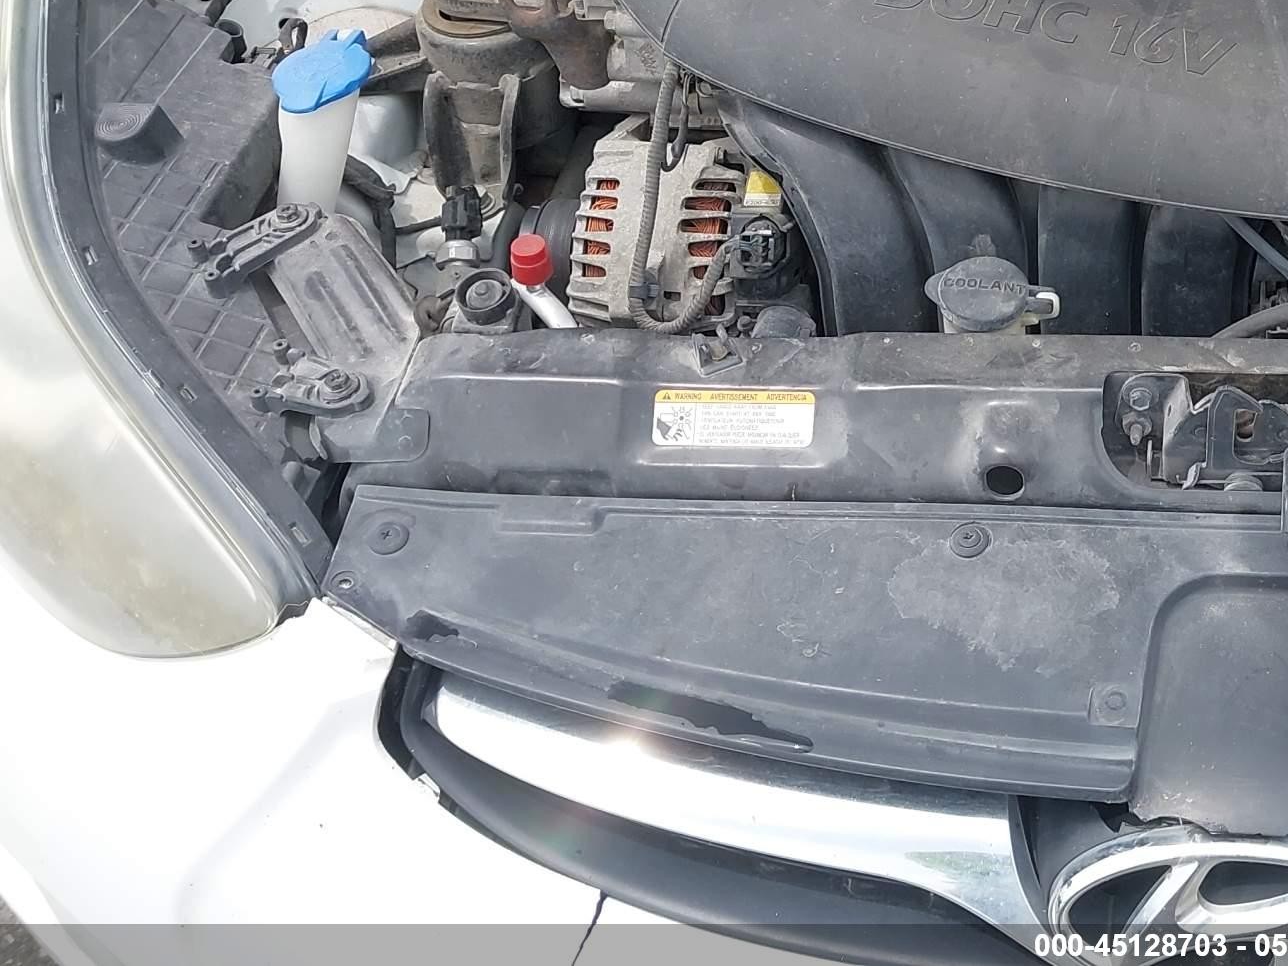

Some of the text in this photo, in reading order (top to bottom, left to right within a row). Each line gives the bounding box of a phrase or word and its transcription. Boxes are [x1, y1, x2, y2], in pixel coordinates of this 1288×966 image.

[1109, 15, 1239, 76] 16V
[943, 277, 1026, 295] COOLANT
[710, 393, 758, 401] AVERTISSEMENT
